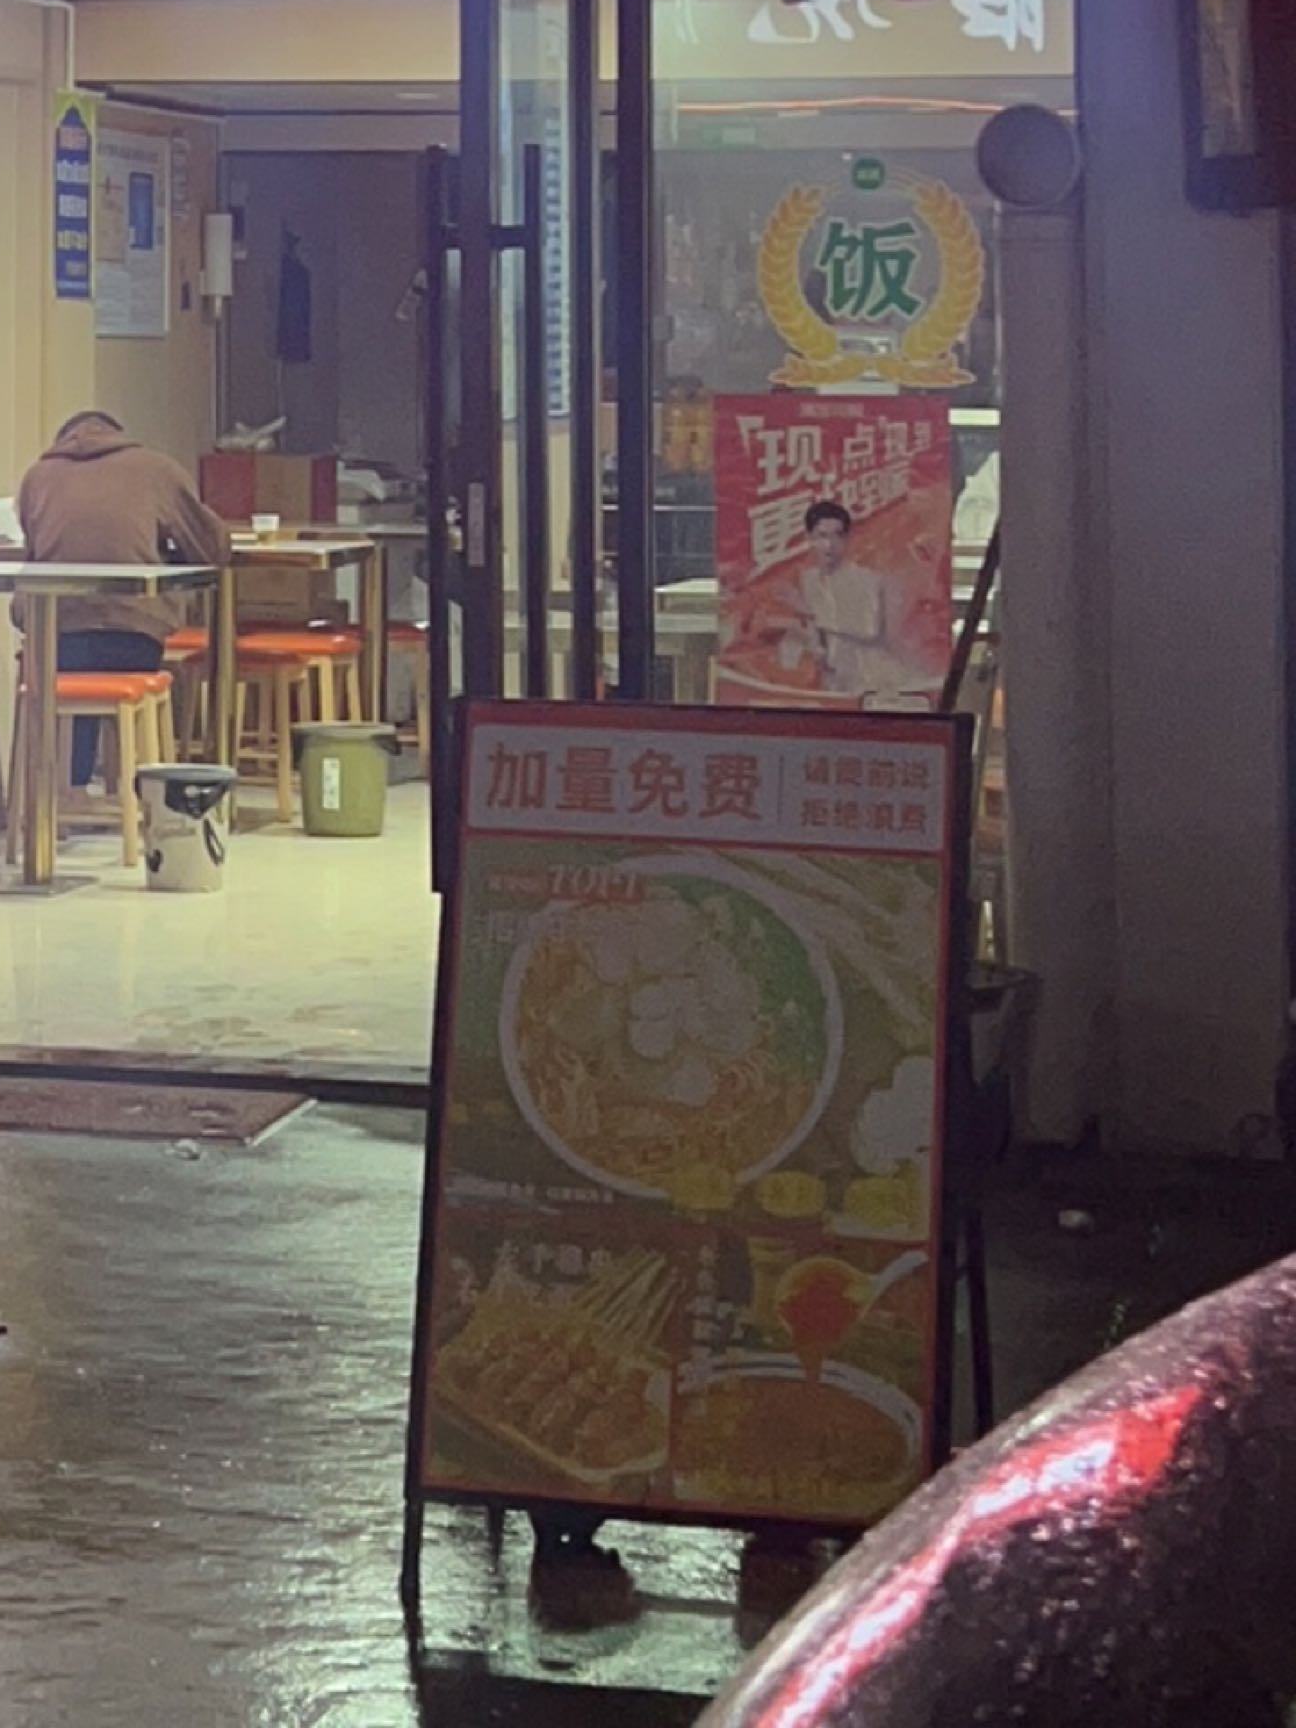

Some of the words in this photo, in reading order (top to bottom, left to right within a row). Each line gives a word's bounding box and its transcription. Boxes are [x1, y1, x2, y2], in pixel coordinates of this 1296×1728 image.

[817, 217, 923, 321] 饭
[486, 741, 764, 821] 加量免费
